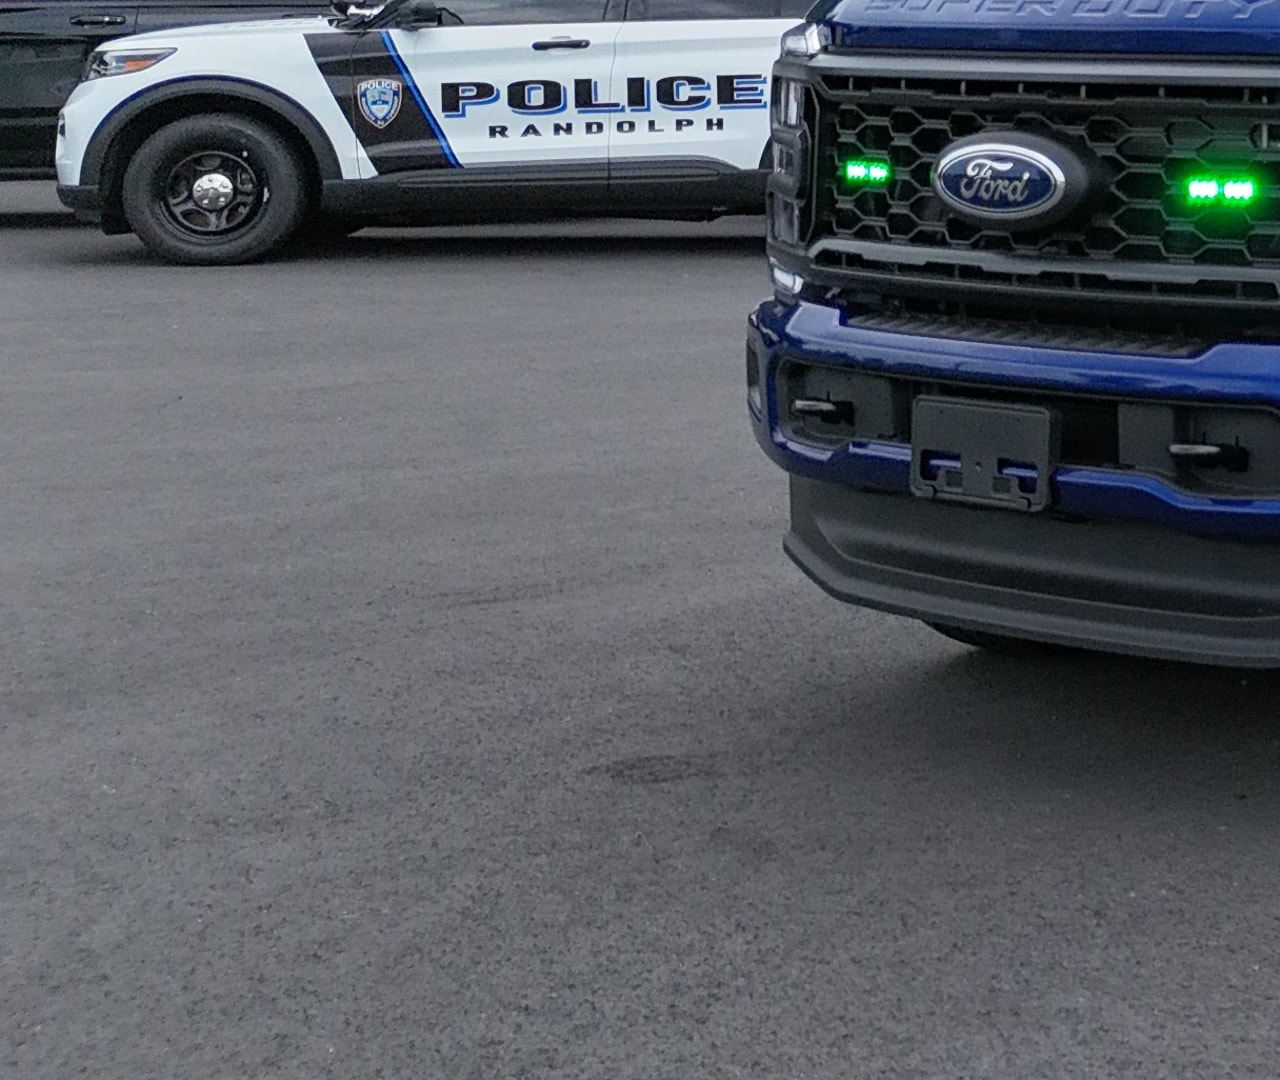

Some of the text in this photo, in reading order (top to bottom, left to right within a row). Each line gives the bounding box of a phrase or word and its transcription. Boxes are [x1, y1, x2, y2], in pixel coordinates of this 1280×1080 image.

[360, 80, 399, 92] POLICE
[440, 73, 768, 119] POLICE
[487, 117, 725, 139] RANDOLPH
[960, 159, 1031, 203] Ford
